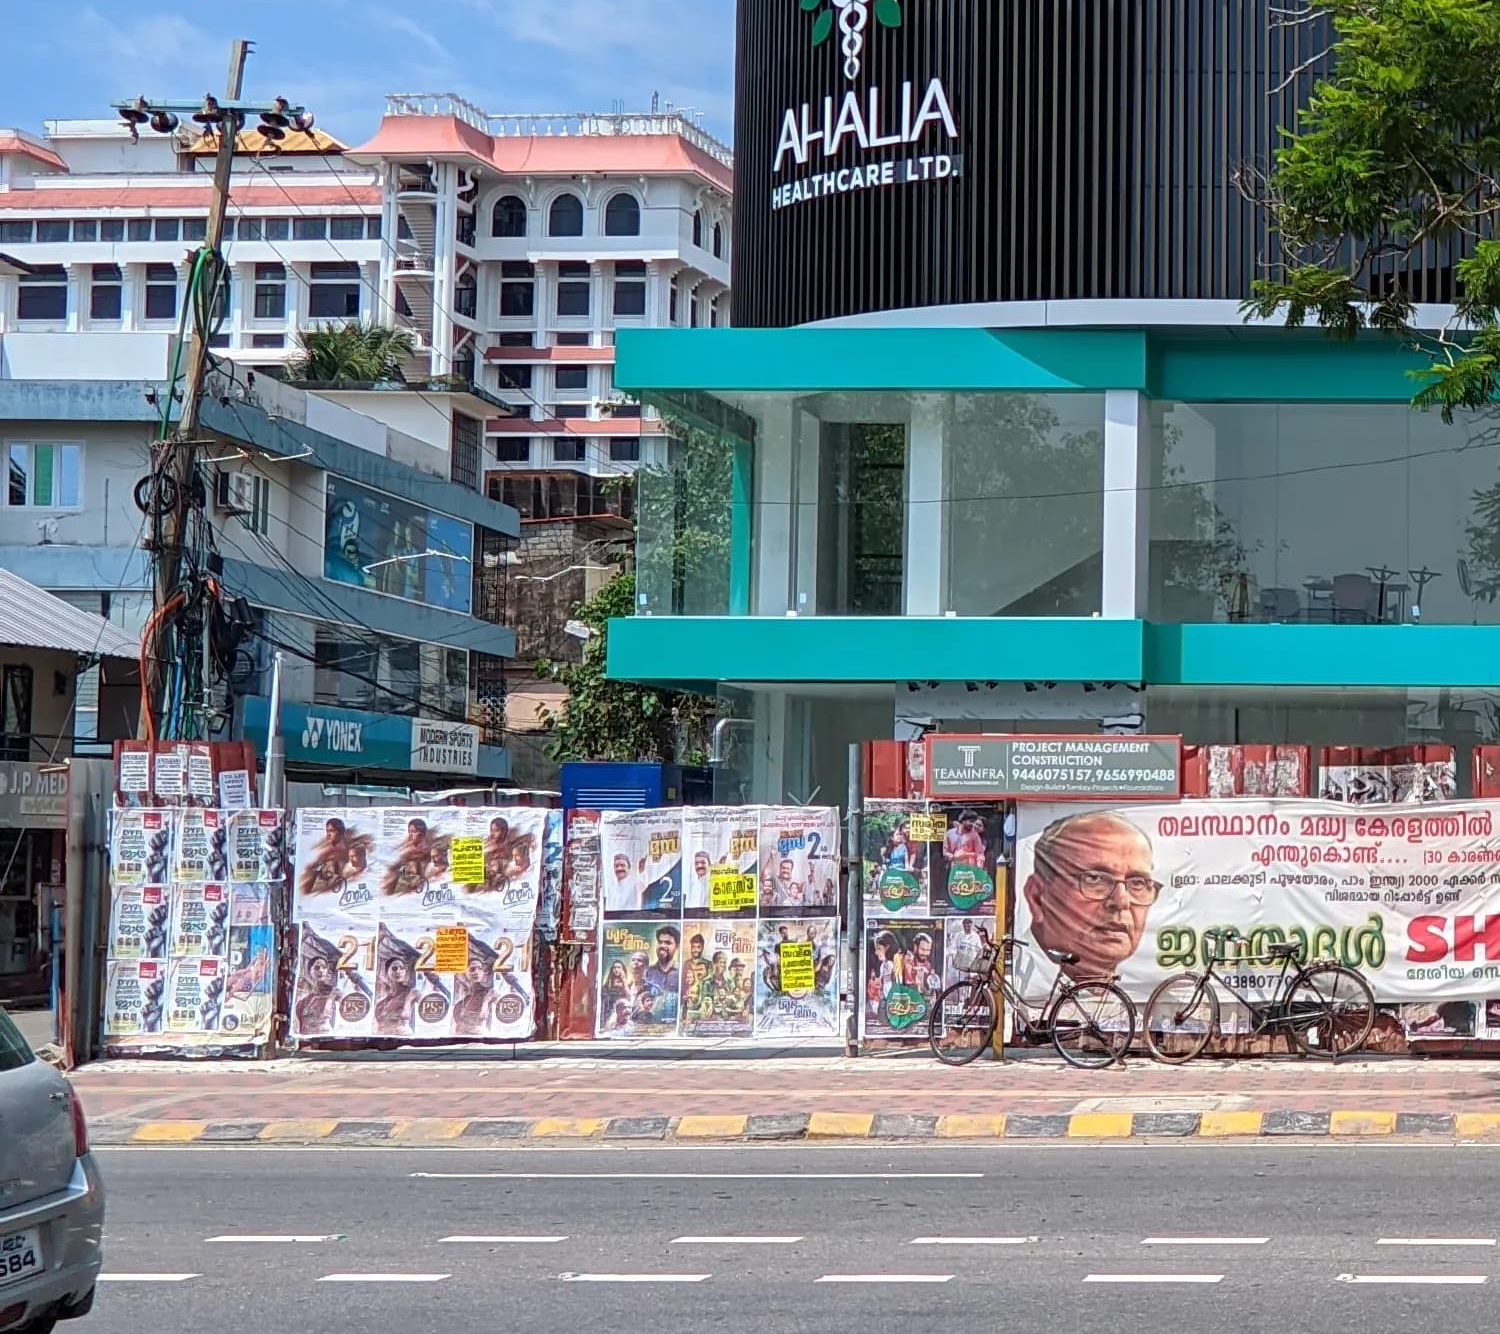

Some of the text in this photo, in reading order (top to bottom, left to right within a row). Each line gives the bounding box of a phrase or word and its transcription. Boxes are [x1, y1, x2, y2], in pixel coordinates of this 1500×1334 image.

[773, 78, 958, 172] AHALIA
[772, 154, 959, 211] HEALTHCARE LTD.
[326, 719, 363, 752] YONEX
[449, 731, 473, 749] SPORTS
[1012, 742, 1150, 754] PROJECT MANAGEMENT
[419, 746, 473, 766] INDUSTRIES
[1012, 755, 1103, 766] CONSTRUCTION
[933, 768, 1005, 780] TEAMINFRA
[1158, 814, 1291, 837] തലസ്ഥാനം
[1355, 810, 1492, 843] കേരളത്തിൽ
[1409, 874, 1439, 886] 2000
[336, 934, 376, 972] 21
[1156, 912, 1387, 969] ജനതാദൾ
[493, 936, 532, 972] 21
[1406, 965, 1465, 980] ദേശീയ
